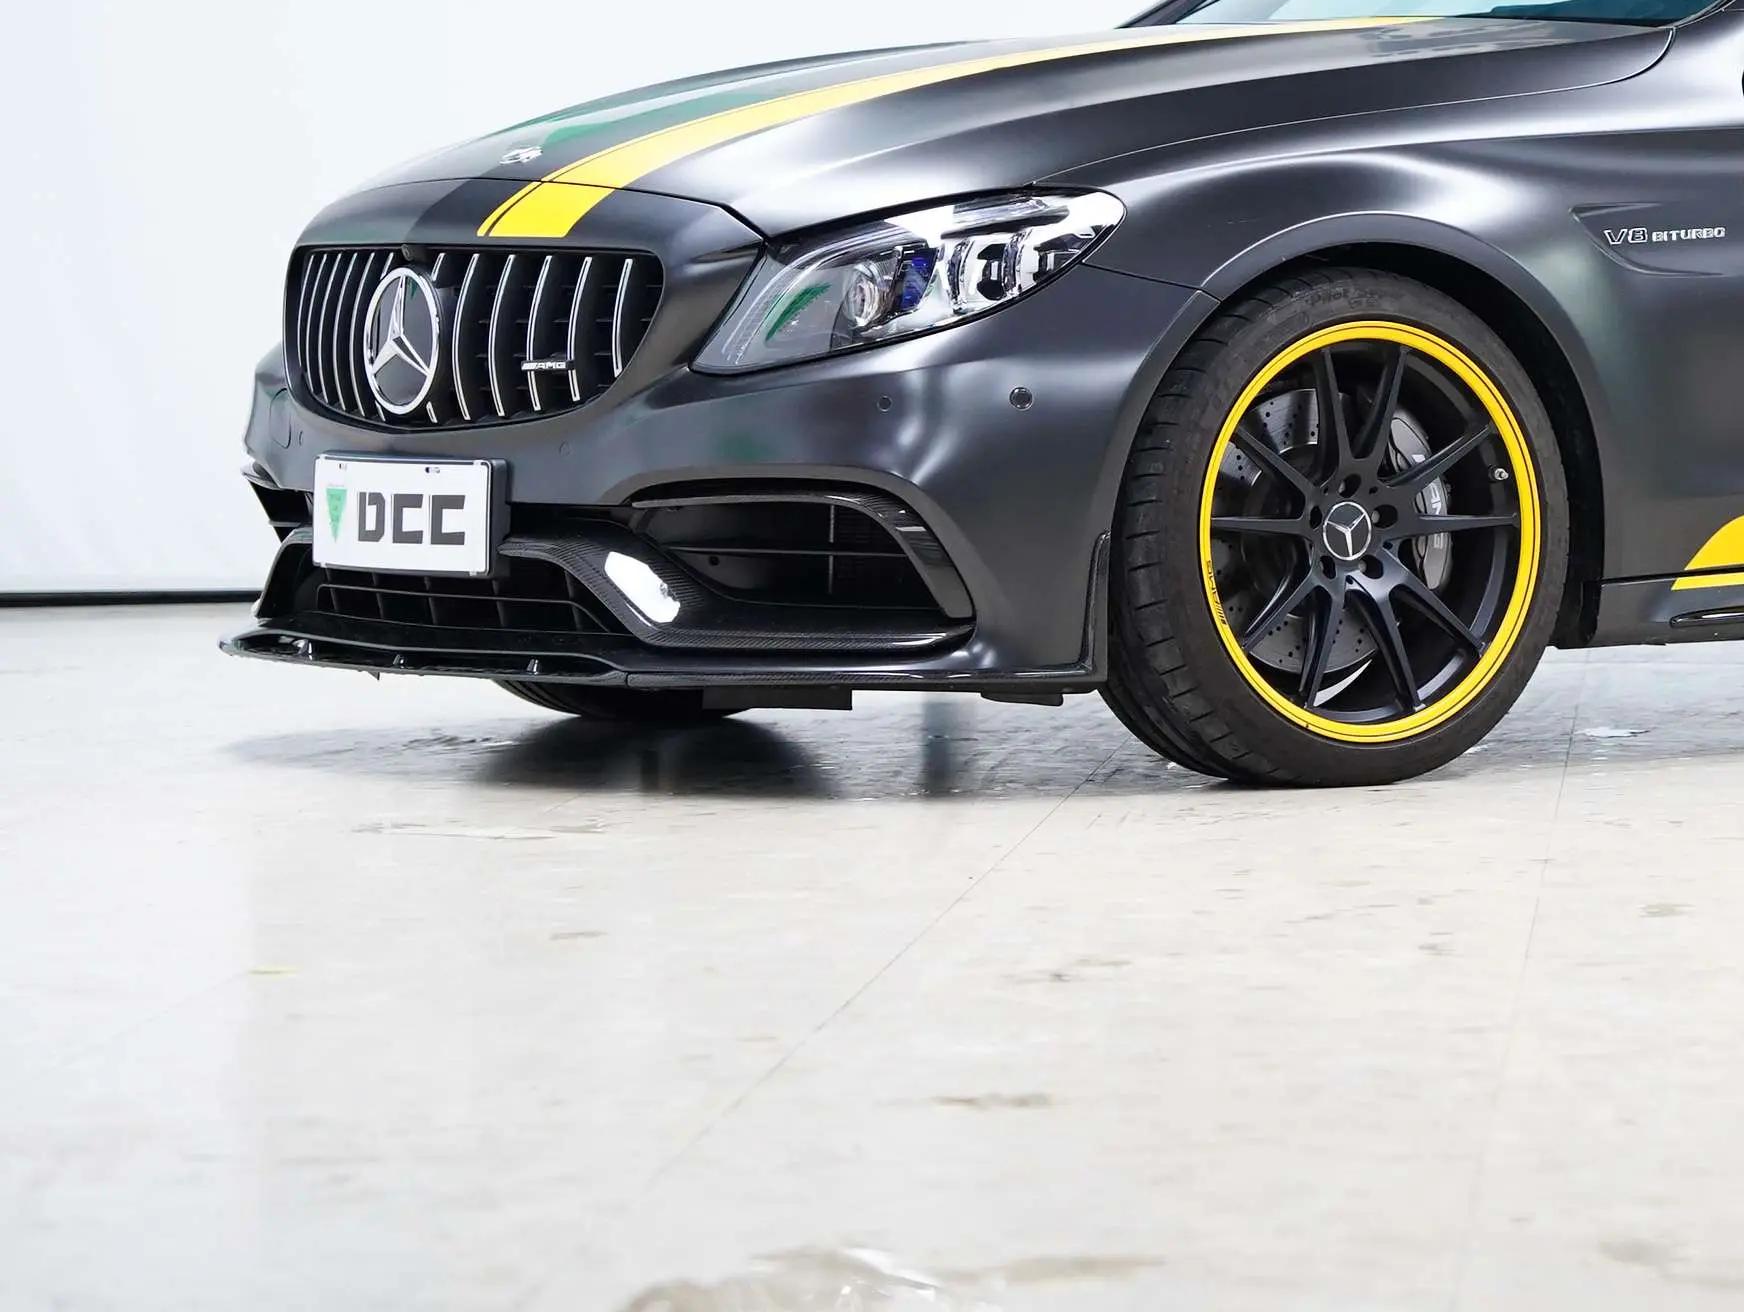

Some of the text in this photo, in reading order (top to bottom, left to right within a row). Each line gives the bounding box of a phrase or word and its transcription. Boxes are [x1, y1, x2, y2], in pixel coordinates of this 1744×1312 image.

[1603, 227, 1726, 245] V8 BITURBO
[357, 491, 466, 546] DCC
